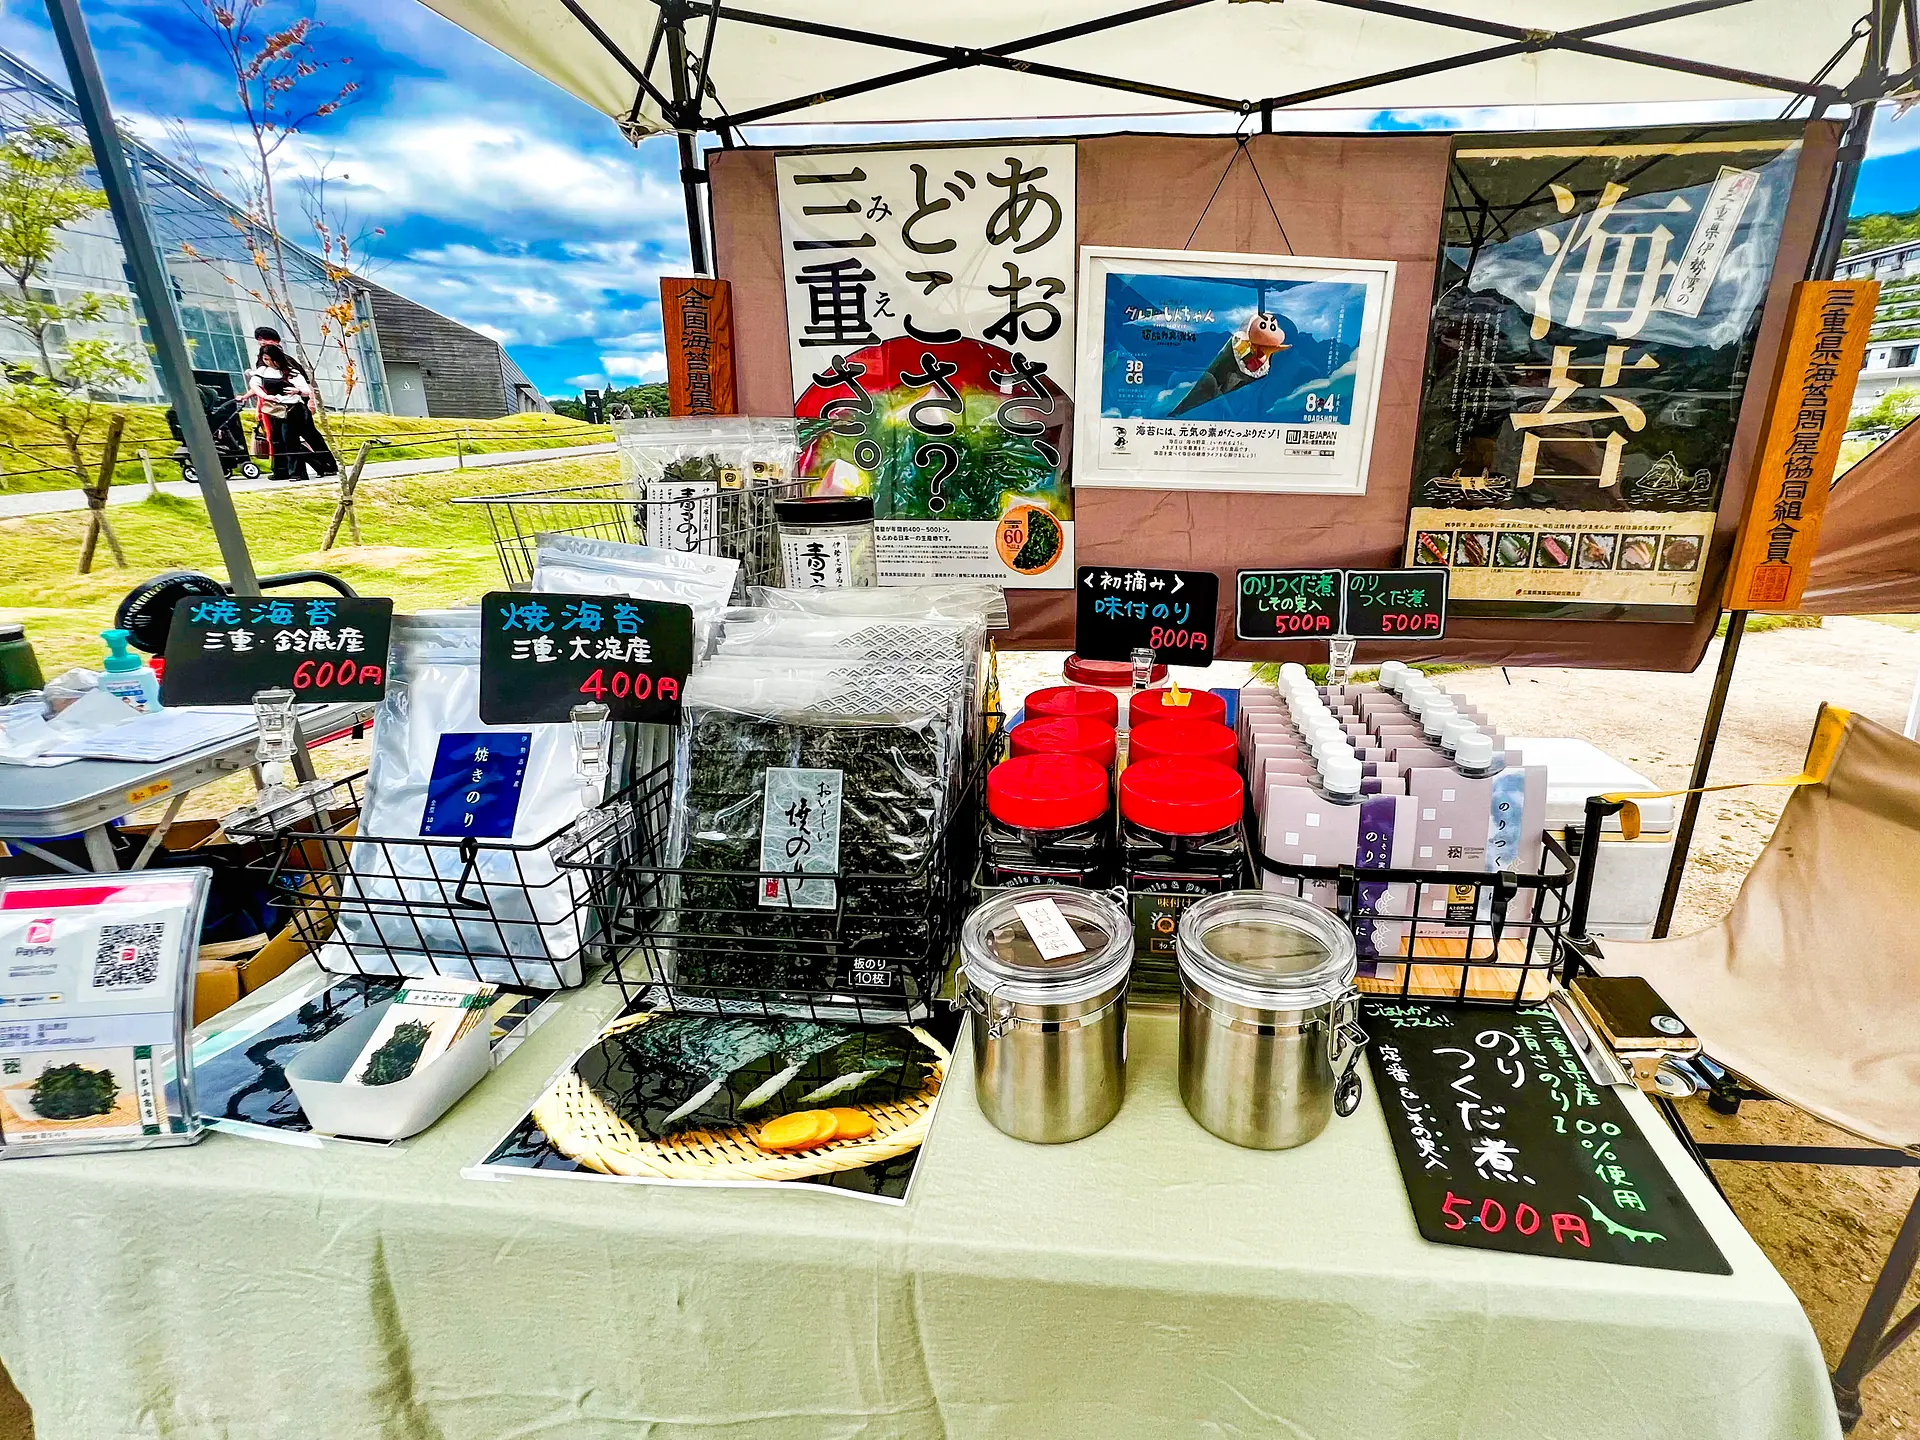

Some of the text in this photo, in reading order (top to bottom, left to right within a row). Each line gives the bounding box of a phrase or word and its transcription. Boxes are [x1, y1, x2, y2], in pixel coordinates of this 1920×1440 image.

[676, 286, 717, 416] 全国海苔問屋
[1511, 182, 1693, 489] 海苔
[1126, 360, 1144, 372] 3D
[1126, 373, 1144, 384] CG
[1003, 529, 1024, 544] 60
[800, 542, 831, 588] 青さ
[1243, 575, 1335, 597] のりつくだ煮
[1350, 575, 1380, 592] のり
[191, 600, 337, 625] 焼海苔
[501, 601, 645, 635] 焼海苔
[1095, 596, 1190, 624] 味付のり
[1275, 614, 1330, 634] 500円
[1381, 614, 1439, 632] 500円
[1150, 626, 1207, 650] 800円
[293, 659, 383, 690] 600円
[579, 668, 679, 702] 400円
[464, 747, 490, 828] 焼きのり
[816, 781, 832, 842] おいしい
[785, 798, 812, 892] 焼のり
[15, 946, 57, 957] PayPay
[853, 958, 887, 971] 板のり
[854, 972, 885, 985] 10枚
[1475, 1029, 1527, 1089] のり
[1513, 1025, 1571, 1112] 青さのり
[1539, 1021, 1601, 1107] 三重県産
[1433, 1046, 1537, 1185] つくだ煮
[1441, 1191, 1591, 1248] 500円
